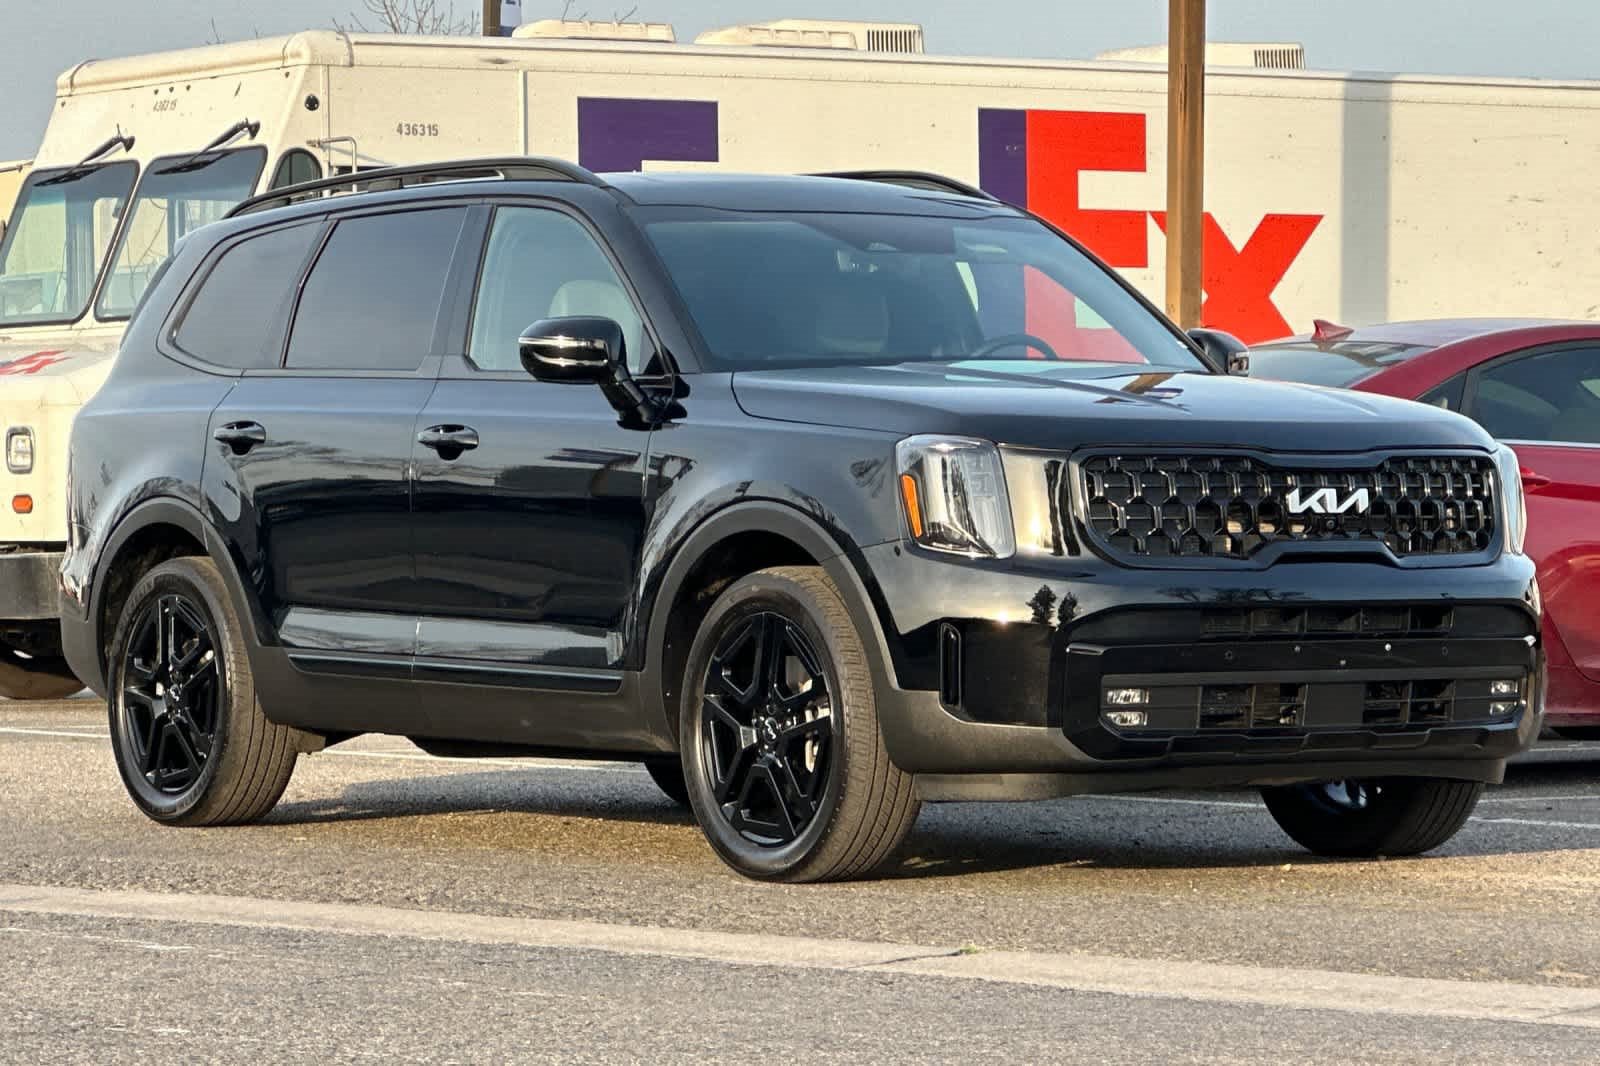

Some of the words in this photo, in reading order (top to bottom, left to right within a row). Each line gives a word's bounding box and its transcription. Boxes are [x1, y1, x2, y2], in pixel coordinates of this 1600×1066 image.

[396, 122, 439, 137] 436315
[577, 97, 1324, 363] dEx
[1286, 487, 1369, 514] KIA
